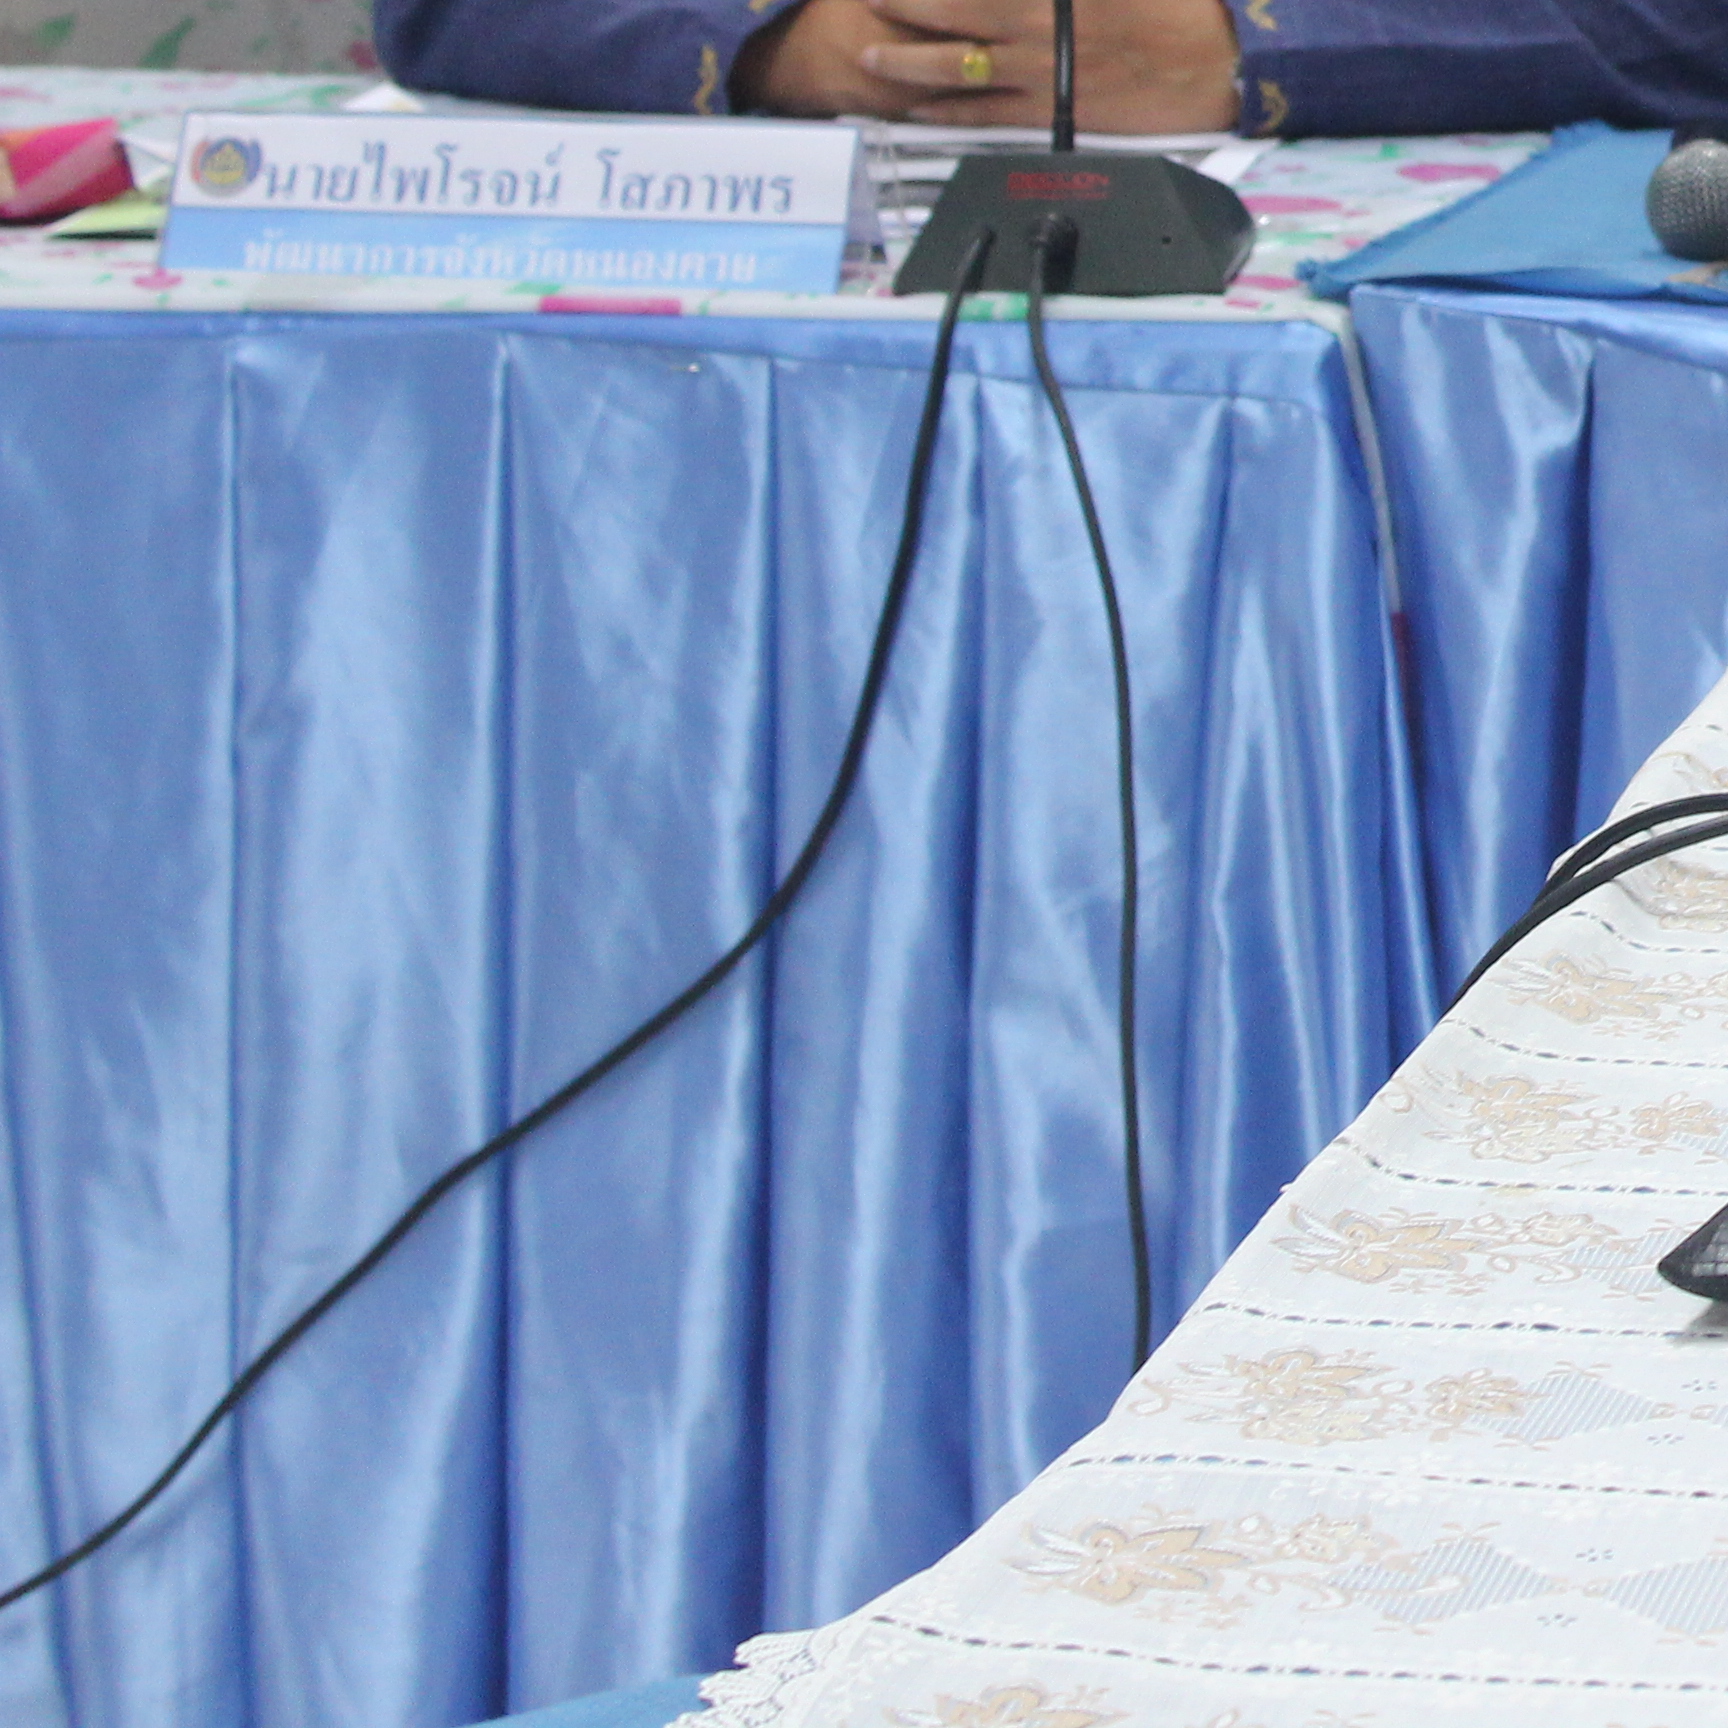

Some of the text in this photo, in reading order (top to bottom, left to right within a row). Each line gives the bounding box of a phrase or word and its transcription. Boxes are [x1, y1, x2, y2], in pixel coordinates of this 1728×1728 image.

[262, 141, 795, 215] นายไพโรจน์ โสภาพร
